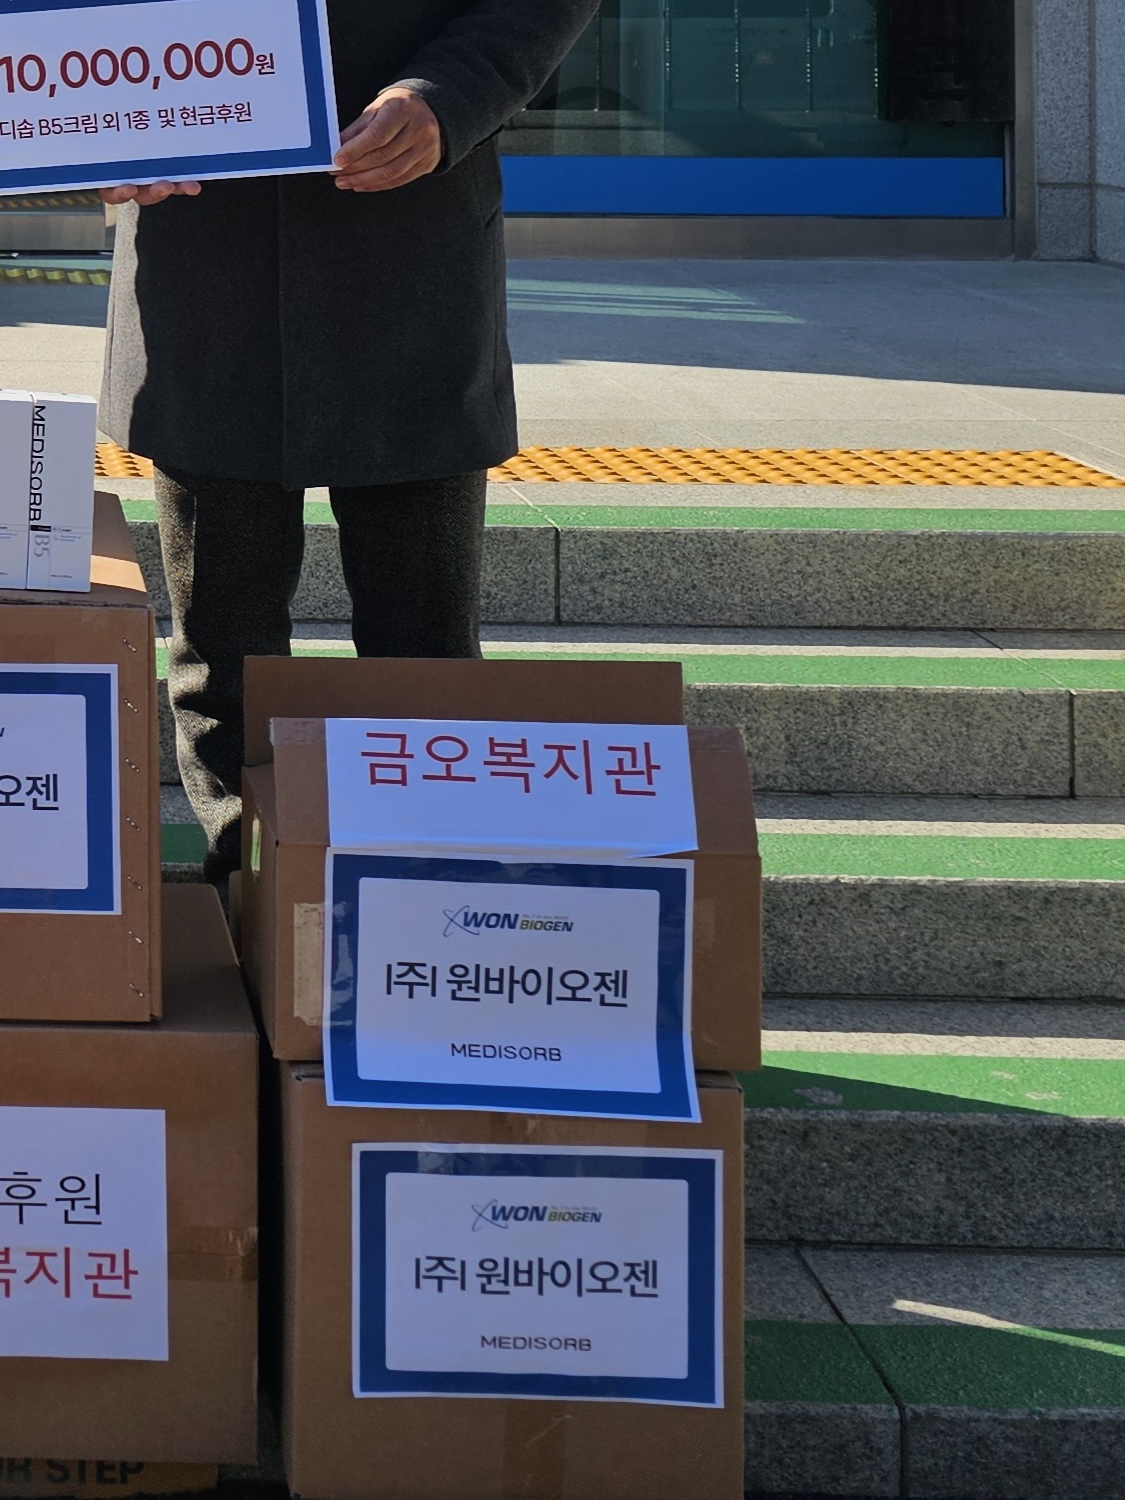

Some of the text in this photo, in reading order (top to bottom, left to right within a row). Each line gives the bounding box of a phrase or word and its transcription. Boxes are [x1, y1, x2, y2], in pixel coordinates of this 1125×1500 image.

[39, 113, 98, 137] B5크림
[157, 107, 176, 129] 및
[179, 101, 252, 127] 현금후원
[28, 405, 46, 522] MEDISORB
[34, 534, 50, 557] B5
[361, 732, 661, 797] 금오복지관
[463, 912, 519, 929] WON
[519, 919, 574, 932] BIOGEN
[451, 1042, 562, 1062] MEDISORB
[491, 1206, 548, 1221] WON
[548, 1211, 602, 1223] BIOGEN
[481, 1335, 592, 1351] MEDISORB
